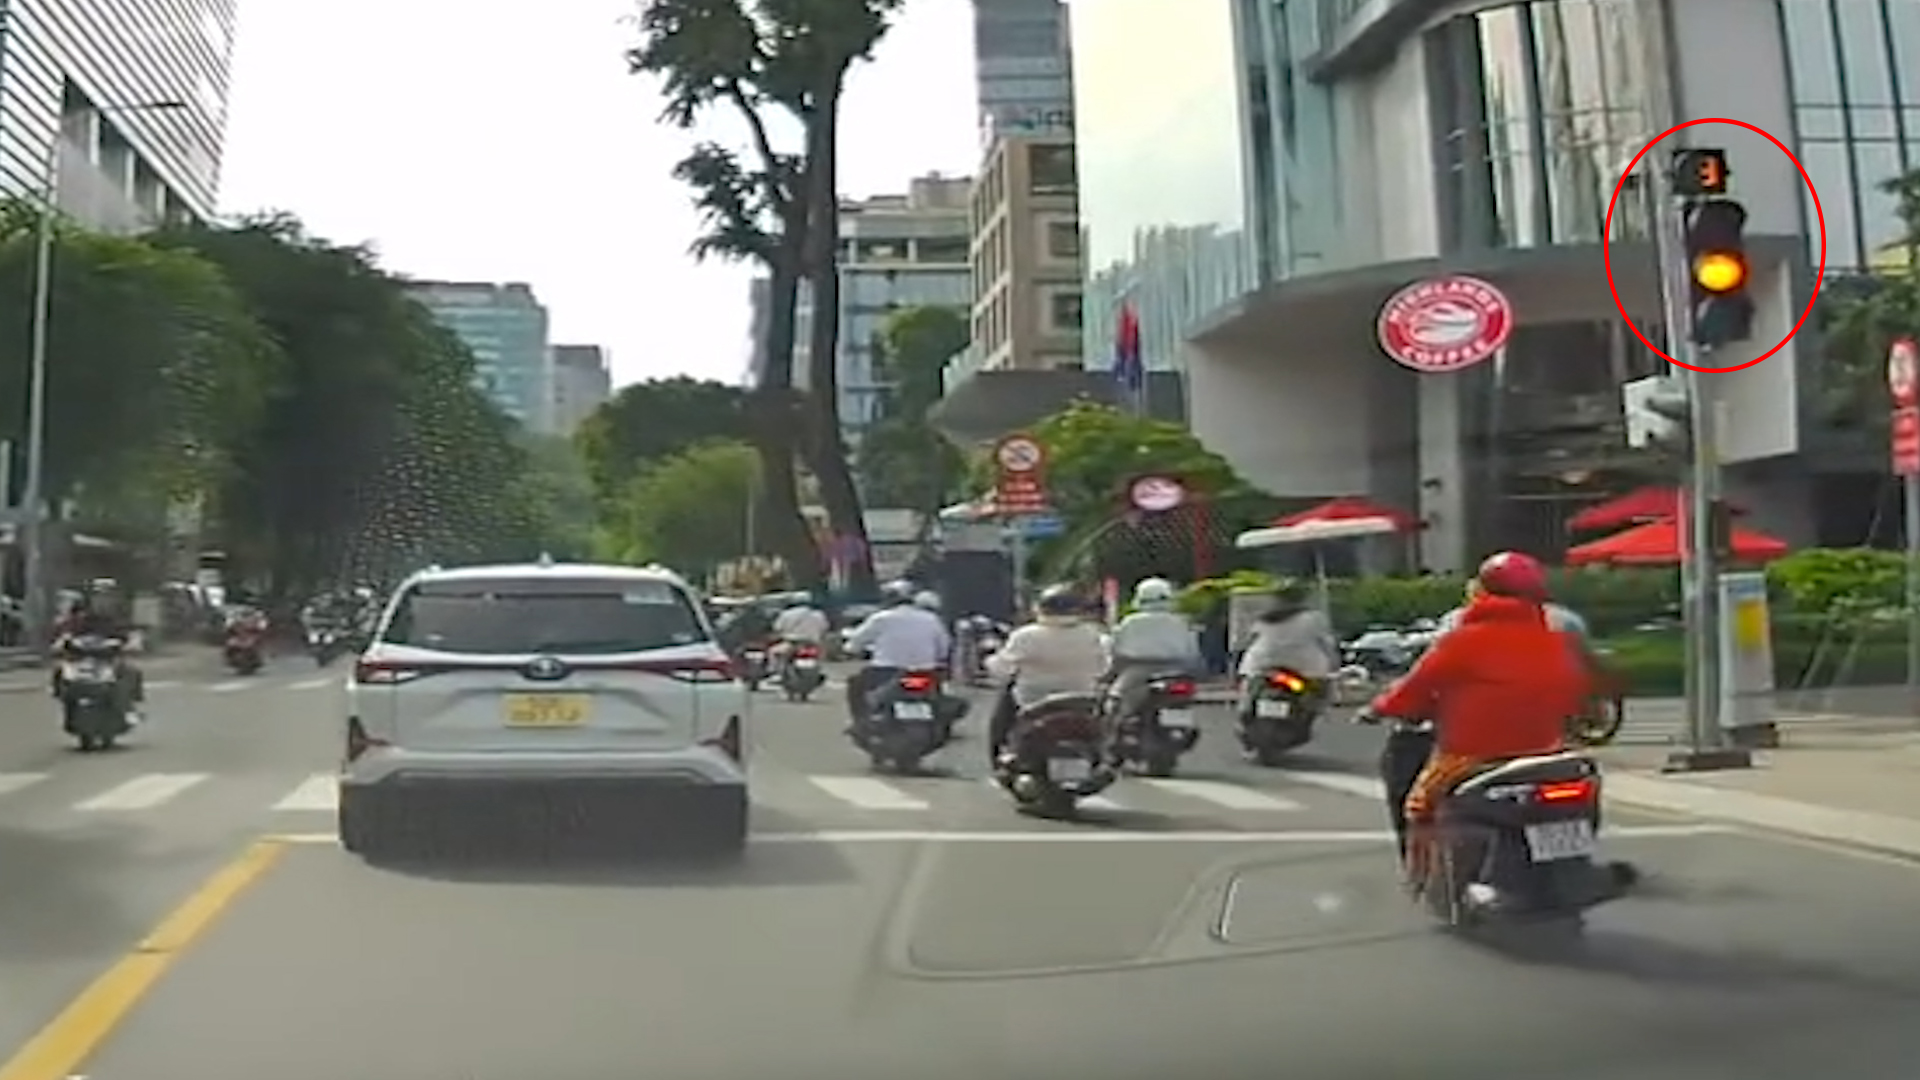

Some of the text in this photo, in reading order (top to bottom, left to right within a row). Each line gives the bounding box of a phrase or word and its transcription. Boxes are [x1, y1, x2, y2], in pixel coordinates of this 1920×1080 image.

[1698, 156, 1718, 187] 3
[1388, 282, 1500, 323] HIGHLANDS
[1402, 338, 1487, 365] COFFEE
